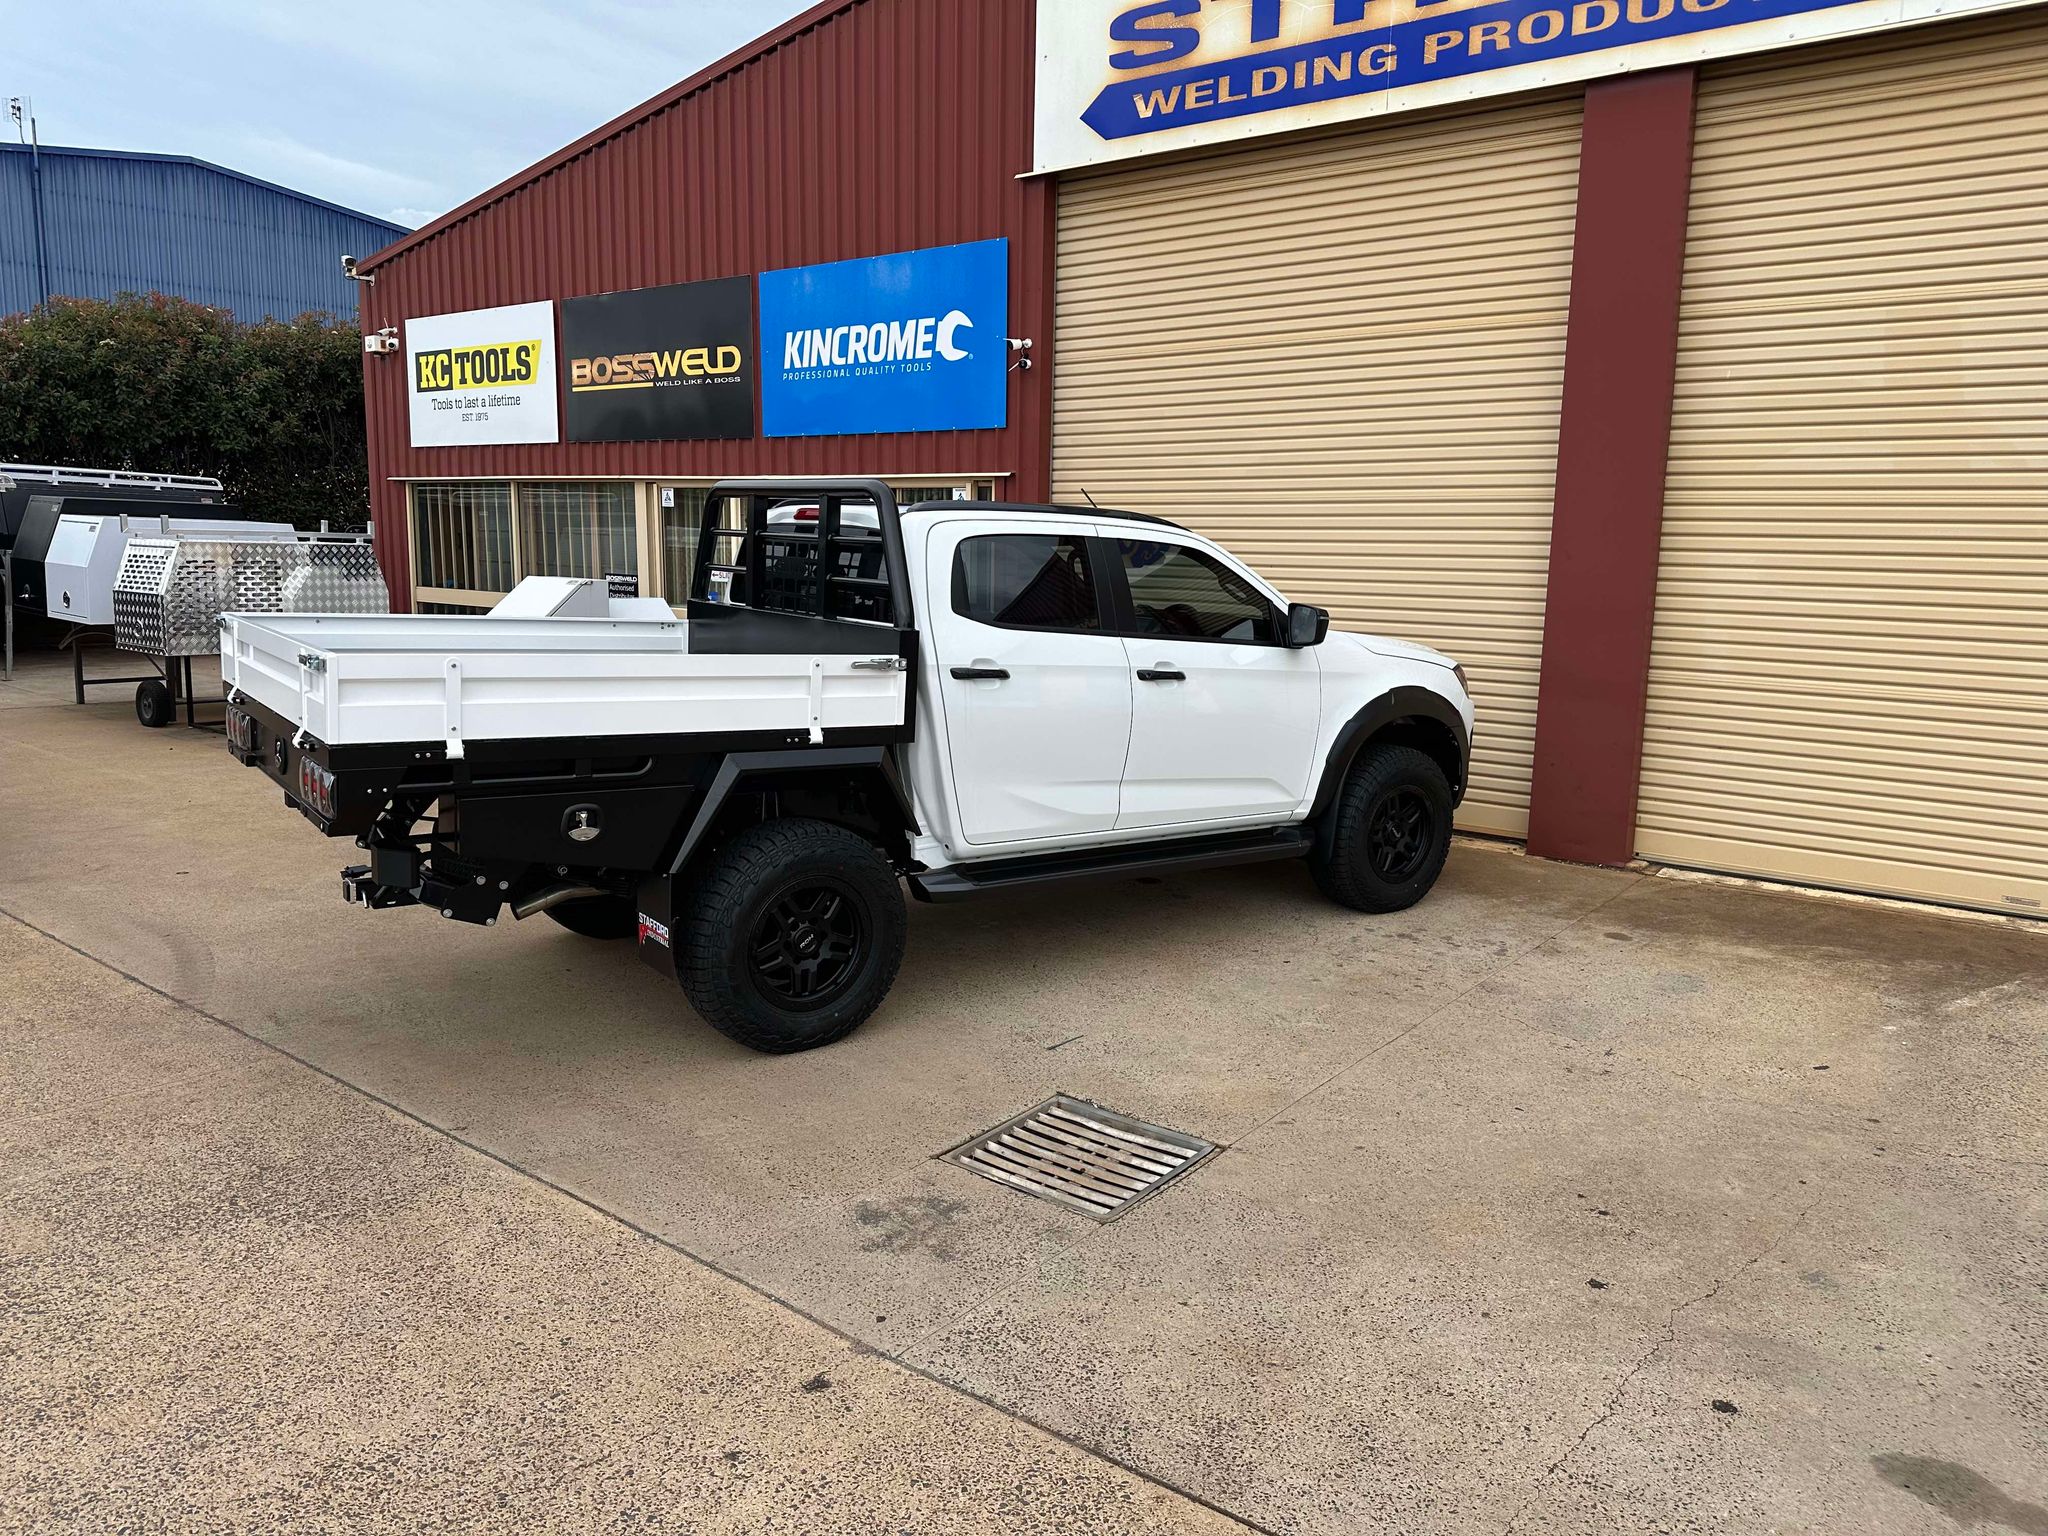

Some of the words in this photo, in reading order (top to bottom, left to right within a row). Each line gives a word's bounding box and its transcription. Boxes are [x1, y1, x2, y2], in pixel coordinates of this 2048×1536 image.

[1132, 43, 1398, 119] WELDING
[783, 317, 936, 370] KINCROME
[418, 353, 450, 389] KC
[454, 345, 532, 385] TOOLS
[571, 345, 742, 386] BOSSWELD
[782, 368, 851, 381] PROFESSIONAL
[855, 364, 896, 376] QUALITY
[901, 362, 932, 373] TOOLS
[655, 380, 681, 388] WELD
[683, 378, 703, 386] LIKE
[431, 397, 454, 411] Tools
[455, 398, 463, 410] to
[464, 396, 479, 409] last
[481, 398, 487, 408] a
[488, 394, 521, 408] lifetime
[609, 583, 635, 592] Authorised
[638, 911, 669, 939] STAFFORD
